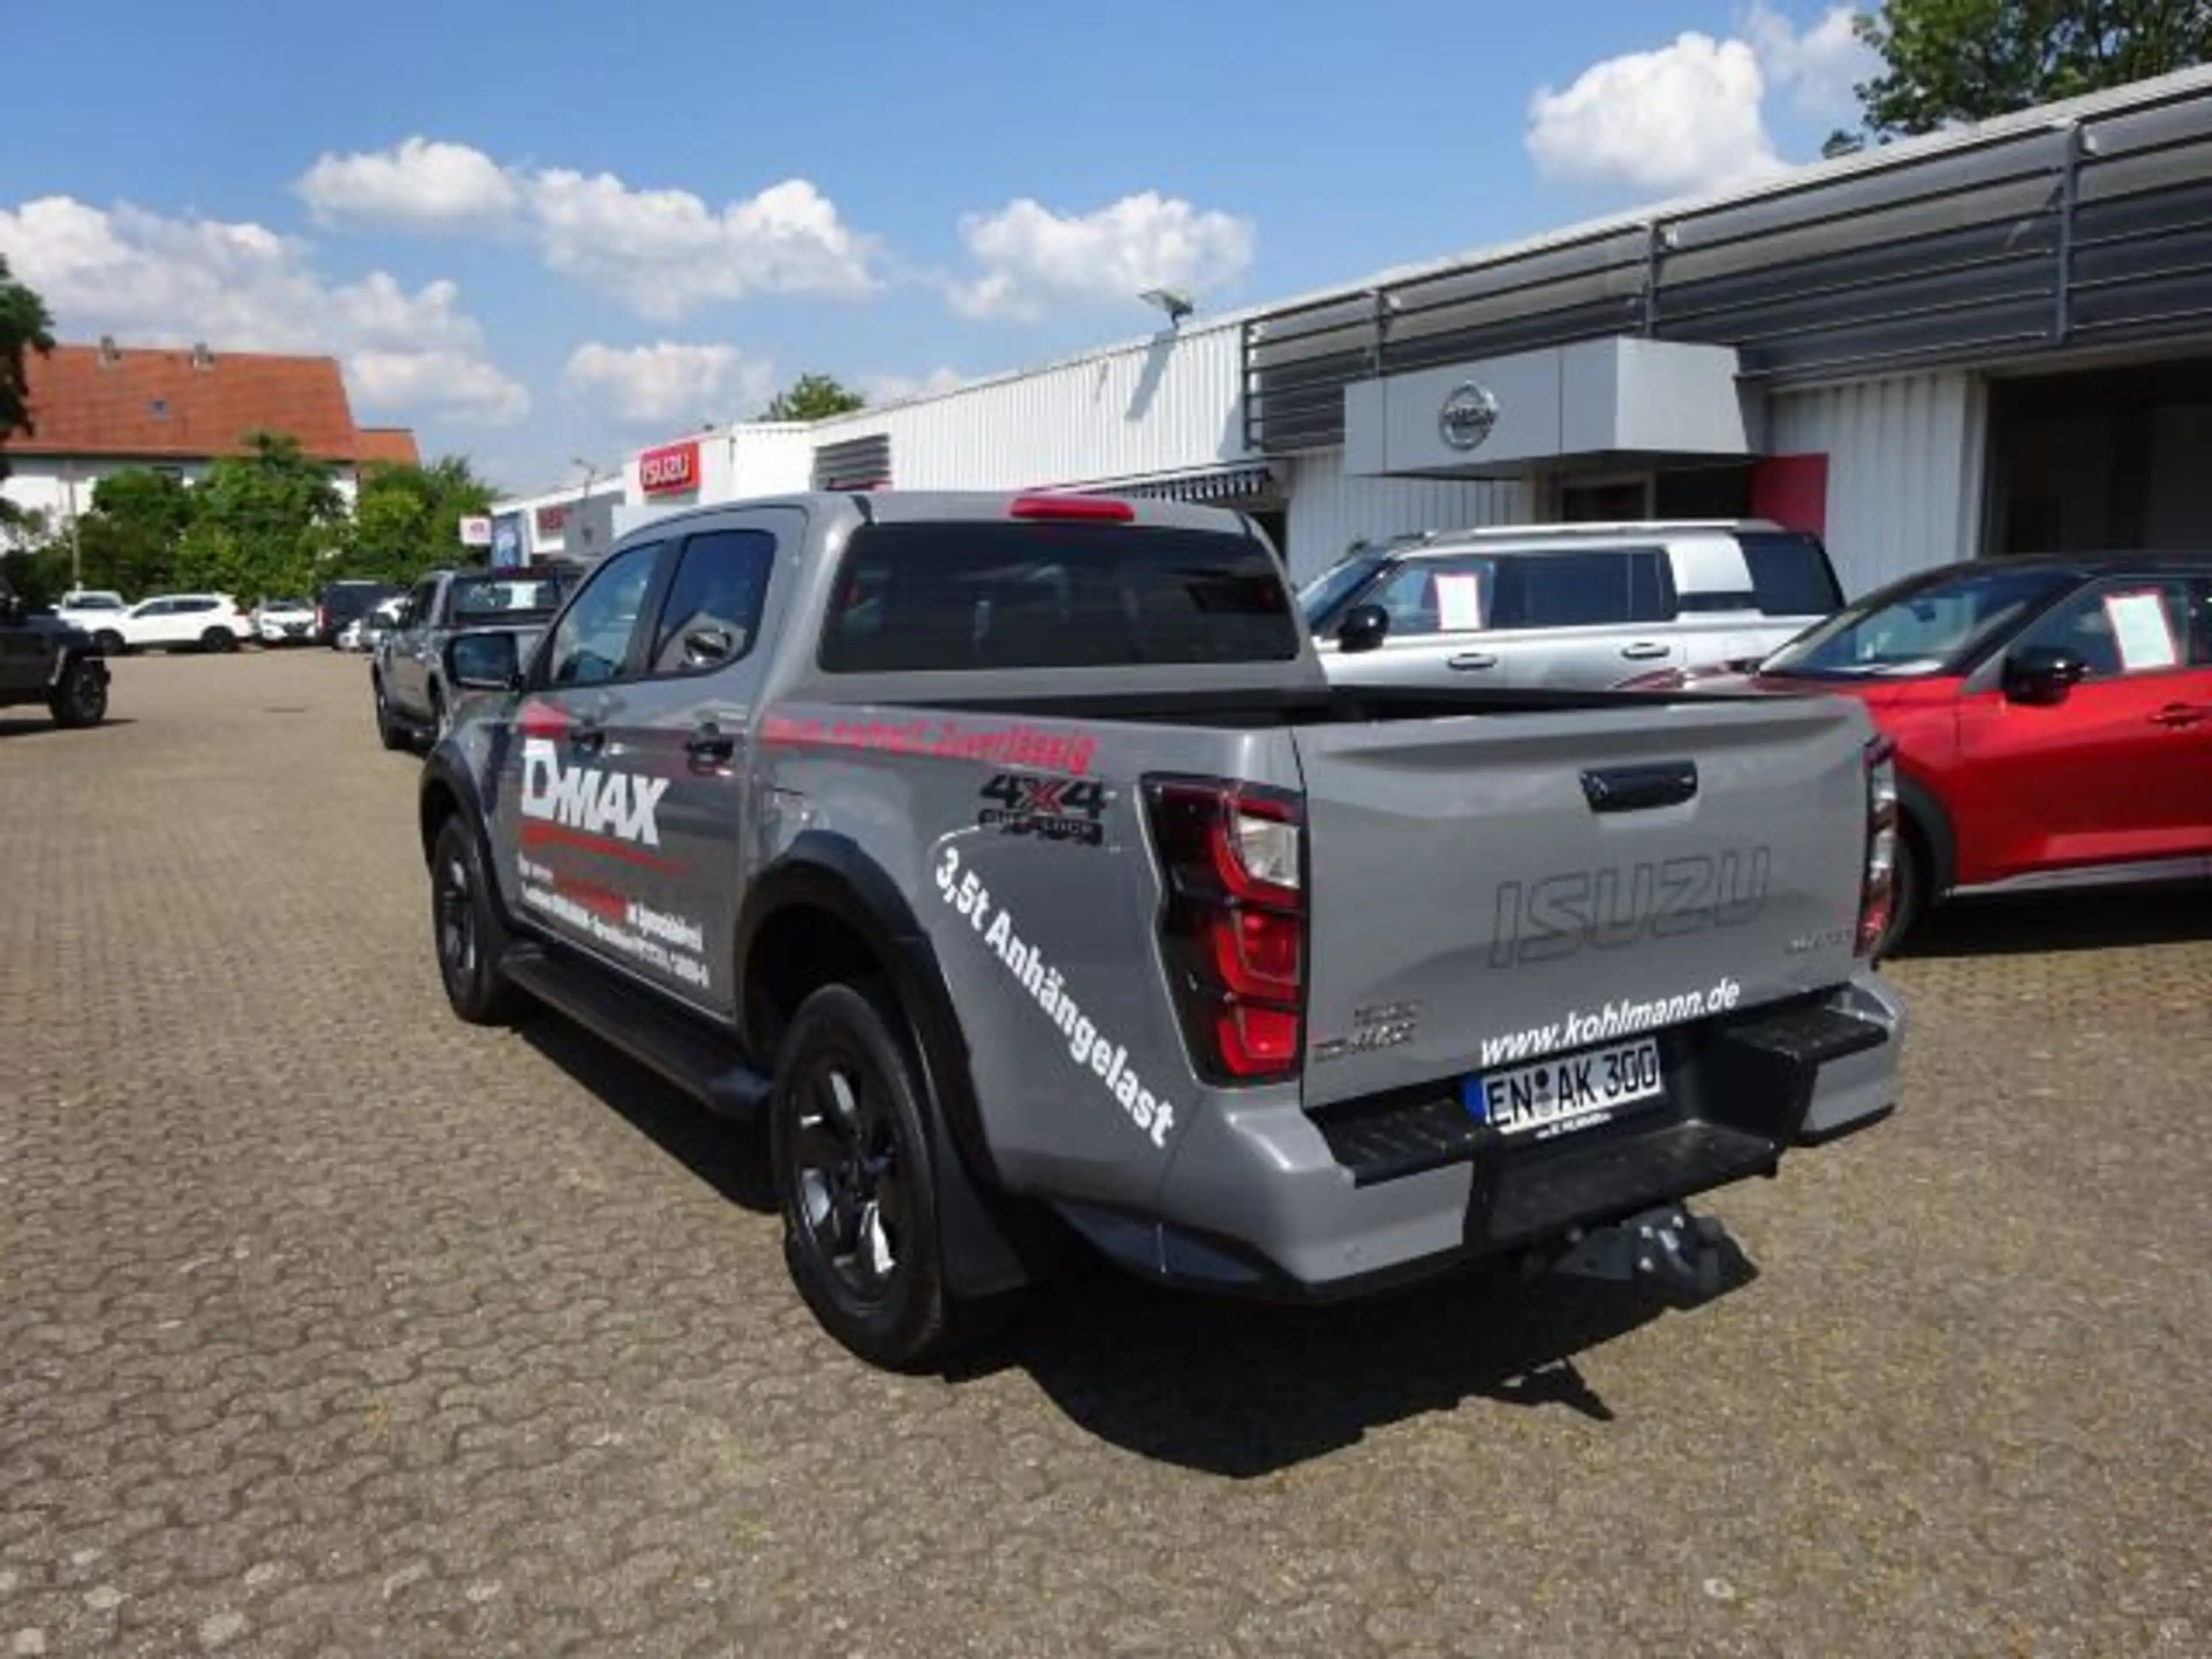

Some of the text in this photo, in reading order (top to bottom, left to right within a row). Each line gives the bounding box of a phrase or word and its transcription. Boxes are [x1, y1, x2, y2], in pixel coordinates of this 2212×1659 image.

[521, 738, 669, 846] DMAX
[1489, 846, 1771, 969] ISUZU
[936, 847, 1175, 1148] 3,5t Anhängelast
[1481, 978, 1740, 1066] www.kohlmann.de
[1487, 1074, 1534, 1128] EN
[1557, 1058, 1597, 1112] AK
[1603, 1045, 1658, 1096] 300
